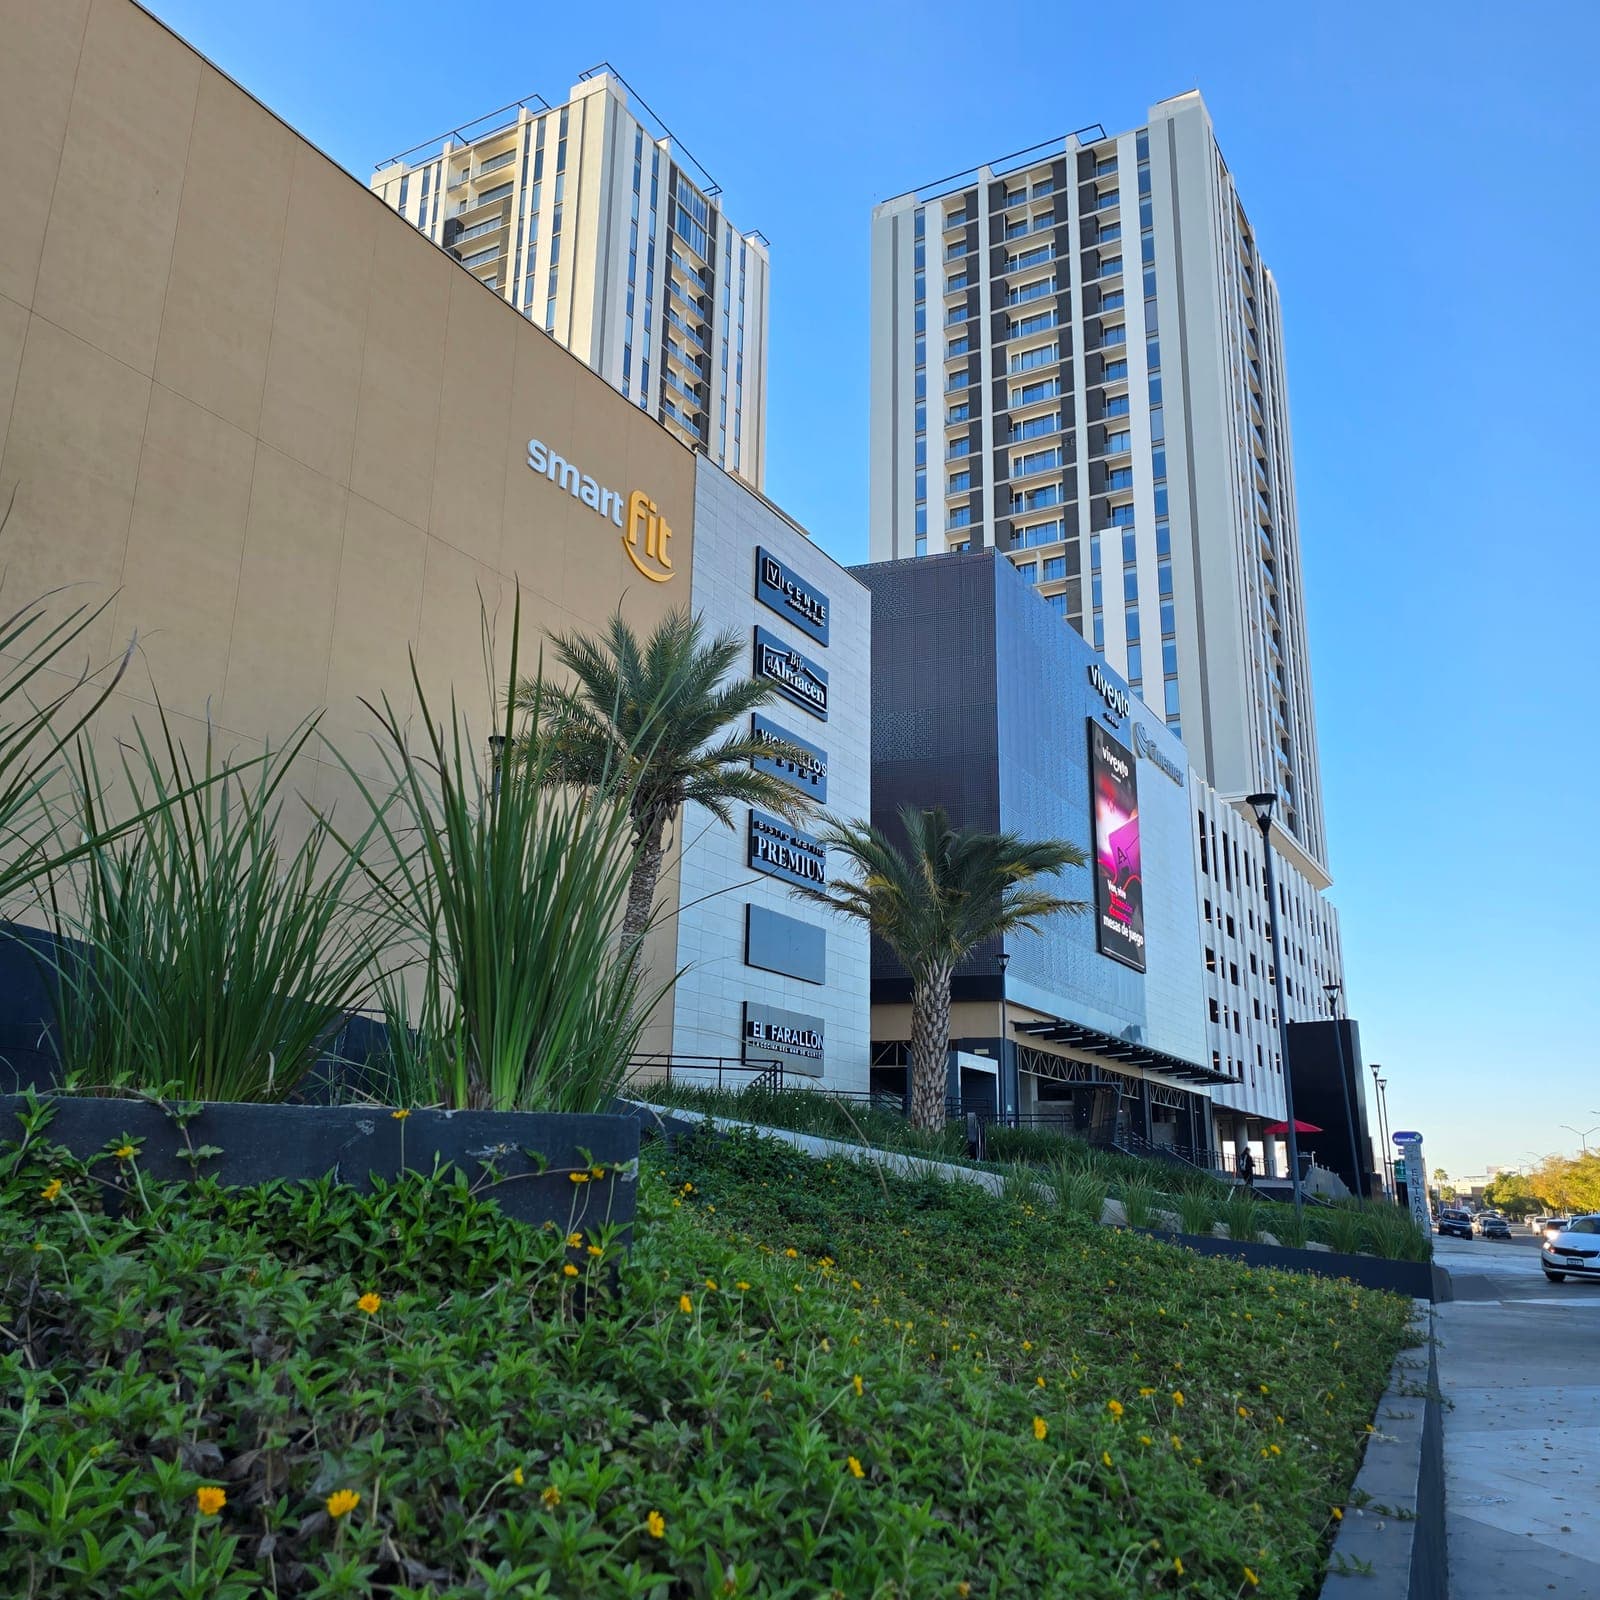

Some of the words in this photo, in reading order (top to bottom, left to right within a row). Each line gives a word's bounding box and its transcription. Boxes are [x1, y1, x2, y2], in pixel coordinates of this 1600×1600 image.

[527, 438, 624, 528] smart
[626, 489, 673, 570] fit
[767, 559, 827, 619] VICENTE
[1090, 664, 1130, 719] vivento
[1102, 746, 1129, 778] vivento
[757, 835, 827, 883] PREMIUM
[1103, 915, 1120, 933] mesas
[1121, 922, 1129, 938] de
[1128, 926, 1144, 947] juego
[753, 1021, 766, 1038] EL
[1411, 1168, 1424, 1222] ENTRAD
